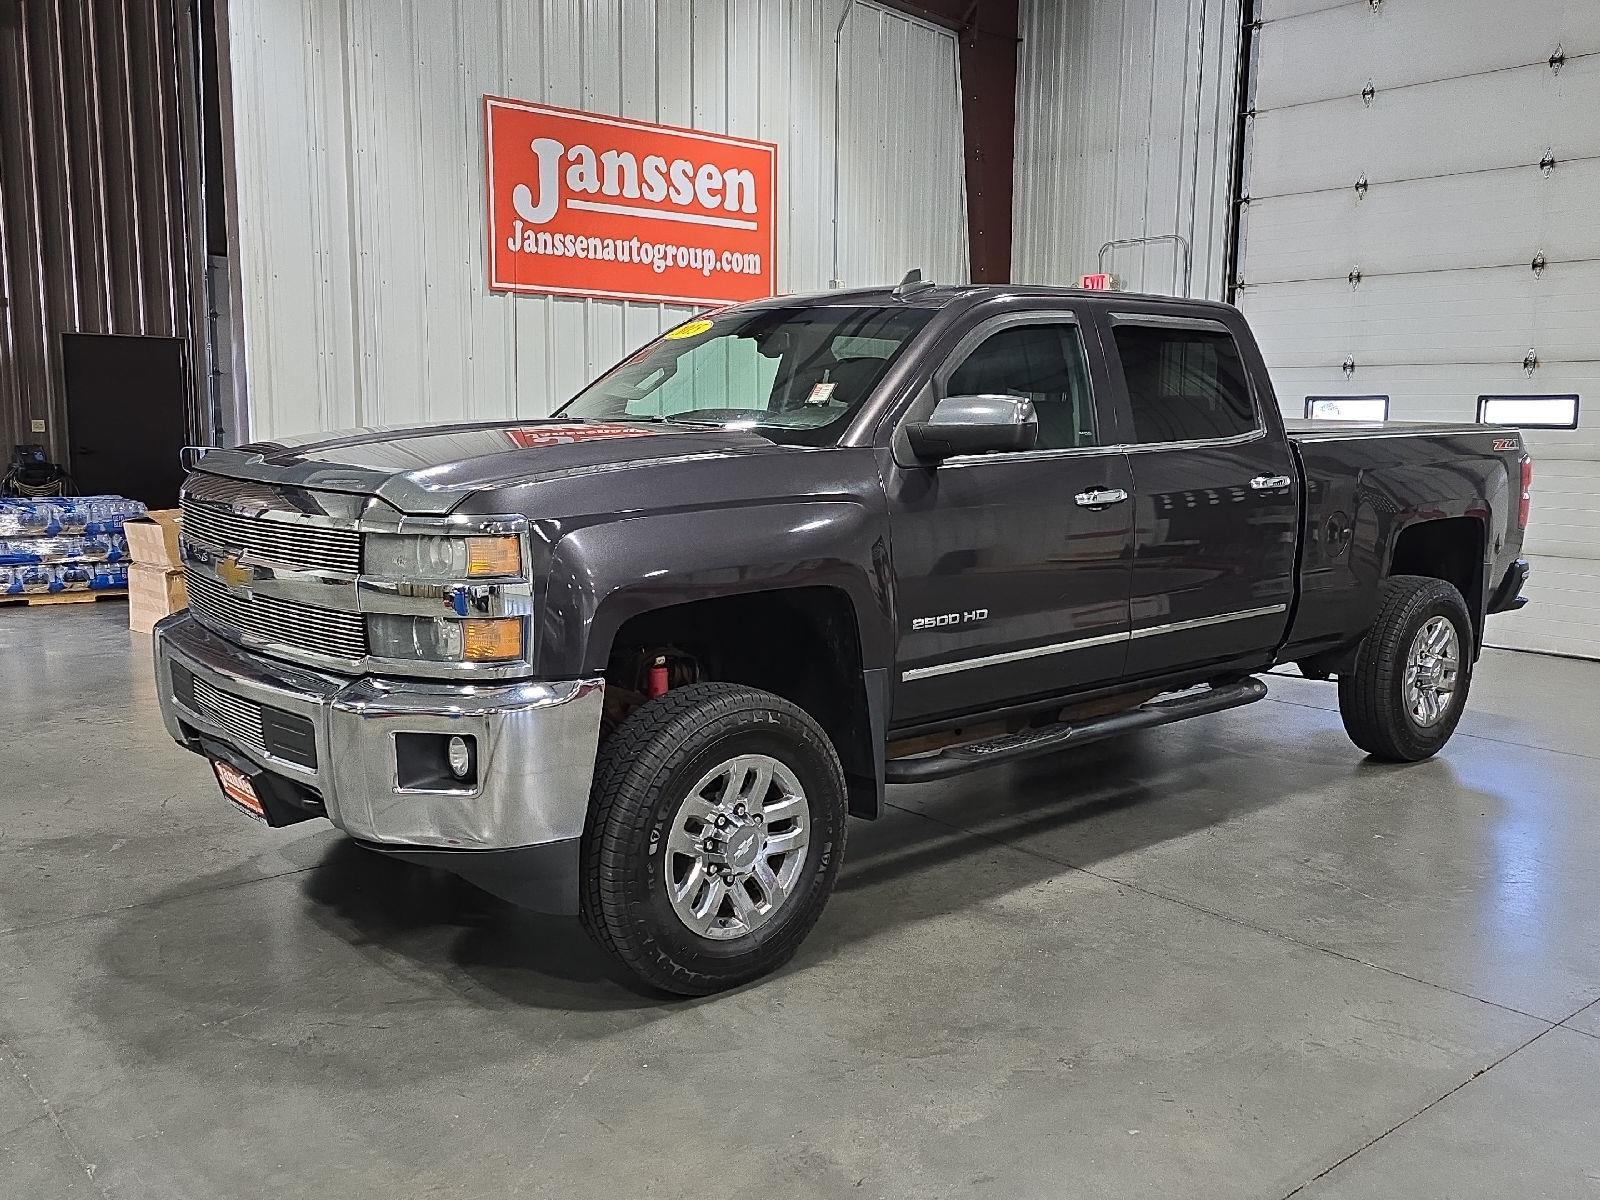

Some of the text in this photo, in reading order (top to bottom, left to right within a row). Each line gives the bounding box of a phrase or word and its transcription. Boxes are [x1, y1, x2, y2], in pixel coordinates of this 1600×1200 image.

[512, 137, 758, 224] Janssen
[507, 219, 761, 277] Janssenautogroup.com
[1083, 275, 1105, 289] EXIT
[1492, 438, 1519, 451] Z71
[912, 608, 988, 630] 2500 HD
